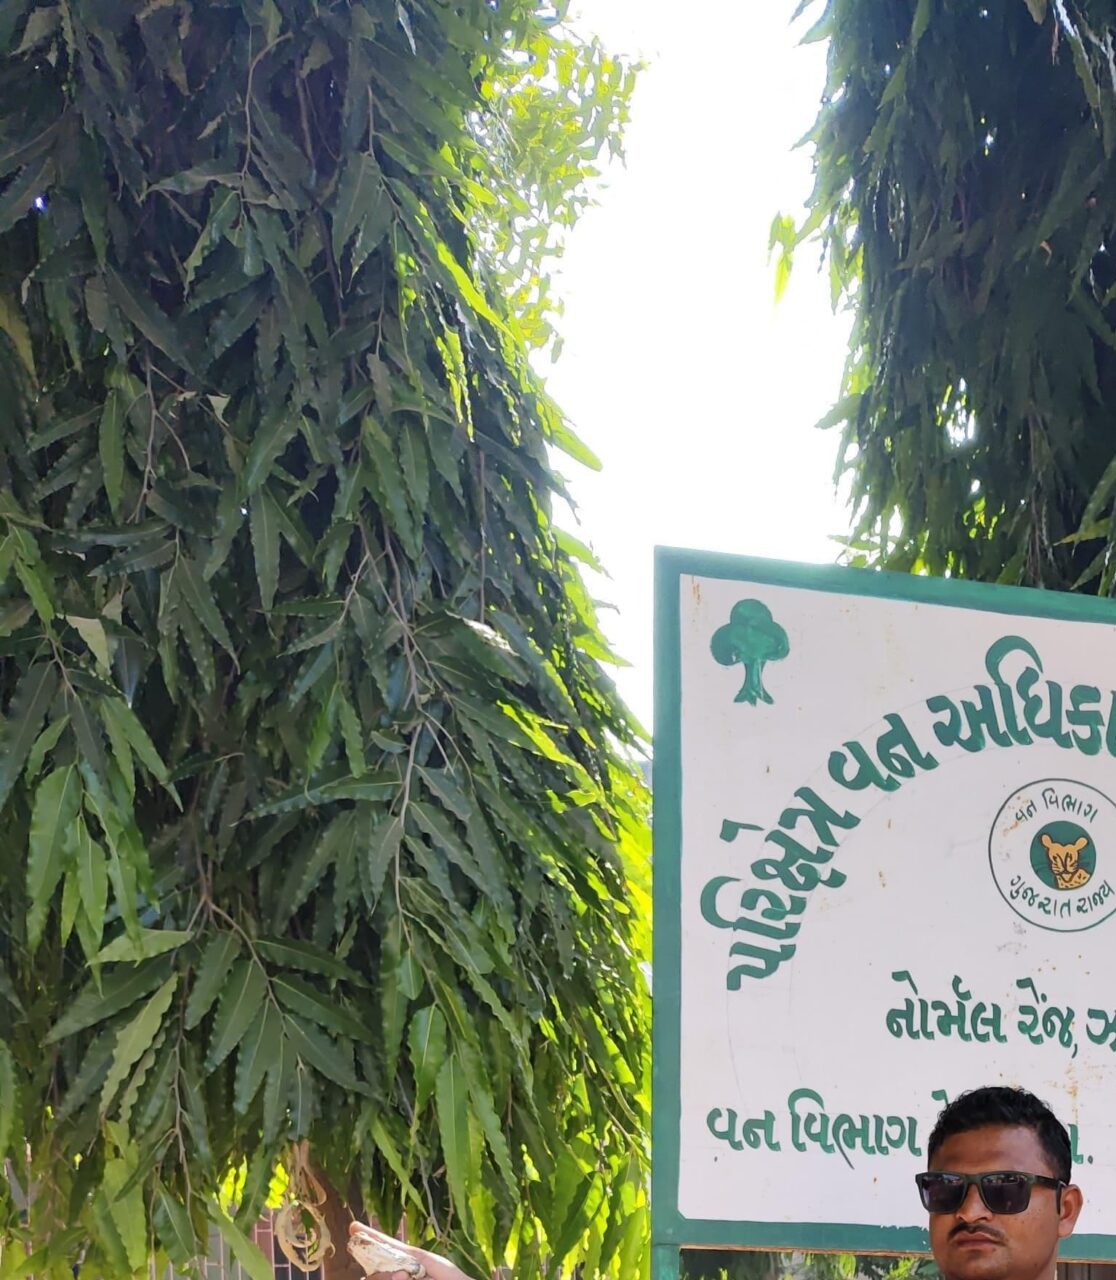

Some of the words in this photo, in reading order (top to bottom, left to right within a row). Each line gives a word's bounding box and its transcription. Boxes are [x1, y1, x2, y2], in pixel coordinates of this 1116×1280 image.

[1015, 799, 1038, 822] વન
[1041, 787, 1099, 823] વિભાગ
[700, 786, 861, 991] પરિક્ષેત્ર
[827, 713, 940, 792] વન
[1009, 875, 1072, 919] ગુજરાત
[1076, 879, 1116, 915] રાજ્ય
[885, 969, 1008, 1044] નોર્મલ
[706, 1106, 781, 1152] વન
[787, 1087, 923, 1170] વિભાગ
